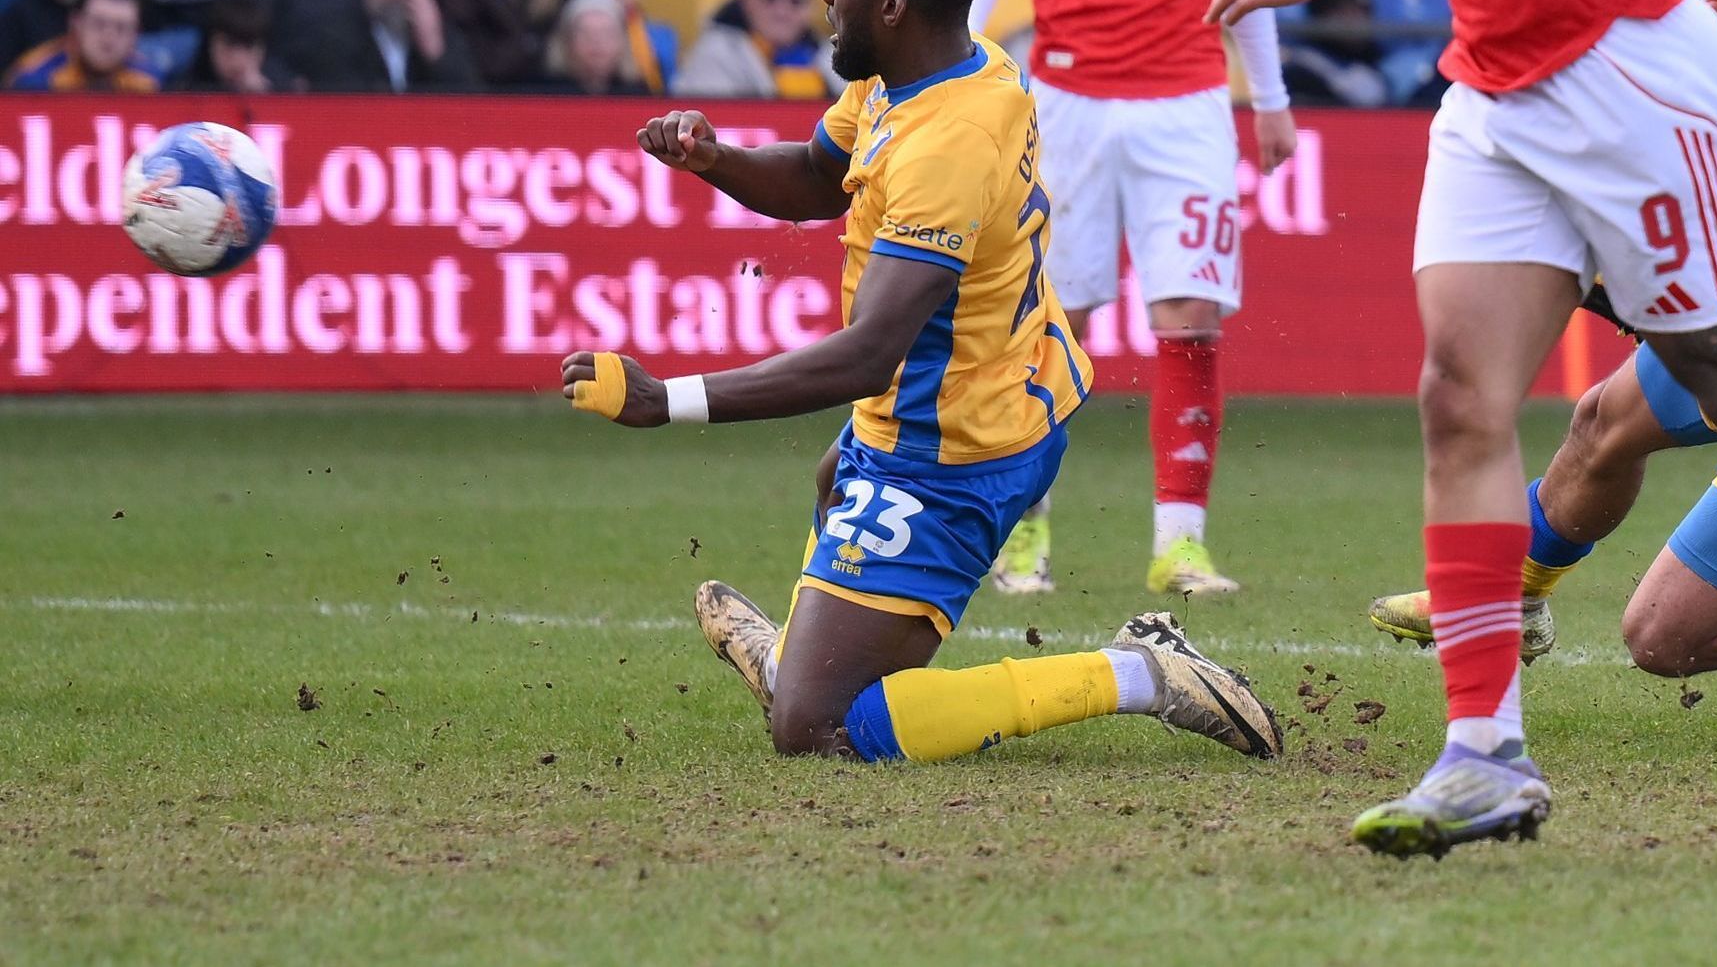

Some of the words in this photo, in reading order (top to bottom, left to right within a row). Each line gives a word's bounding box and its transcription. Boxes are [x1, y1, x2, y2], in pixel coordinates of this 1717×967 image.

[249, 123, 673, 247] Longest
[1179, 195, 1236, 256] 56
[1640, 192, 1690, 277] 9
[498, 251, 834, 356] Estate
[826, 479, 924, 558] 23
[831, 559, 862, 577] errea
